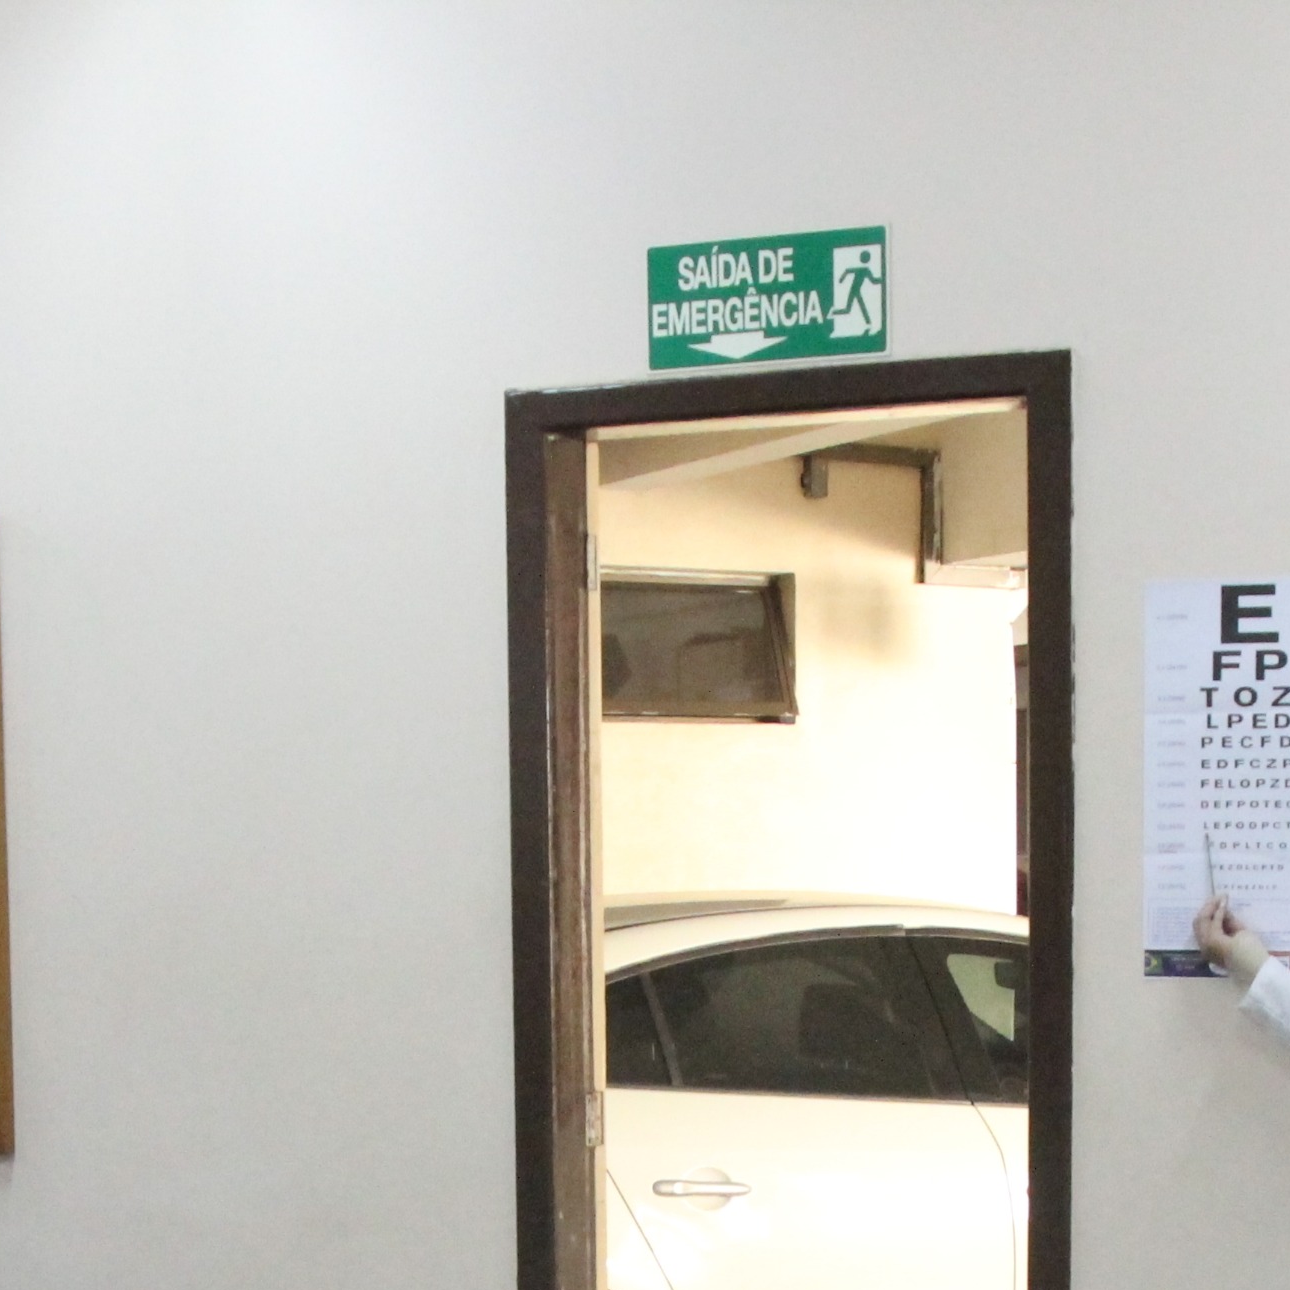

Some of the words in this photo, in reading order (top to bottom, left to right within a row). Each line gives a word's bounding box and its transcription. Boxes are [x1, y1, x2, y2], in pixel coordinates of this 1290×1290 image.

[677, 245, 753, 291] SAÍDA
[759, 247, 795, 284] DE
[652, 287, 824, 338] EMERGÊNCIA
[1220, 584, 1279, 644] E
